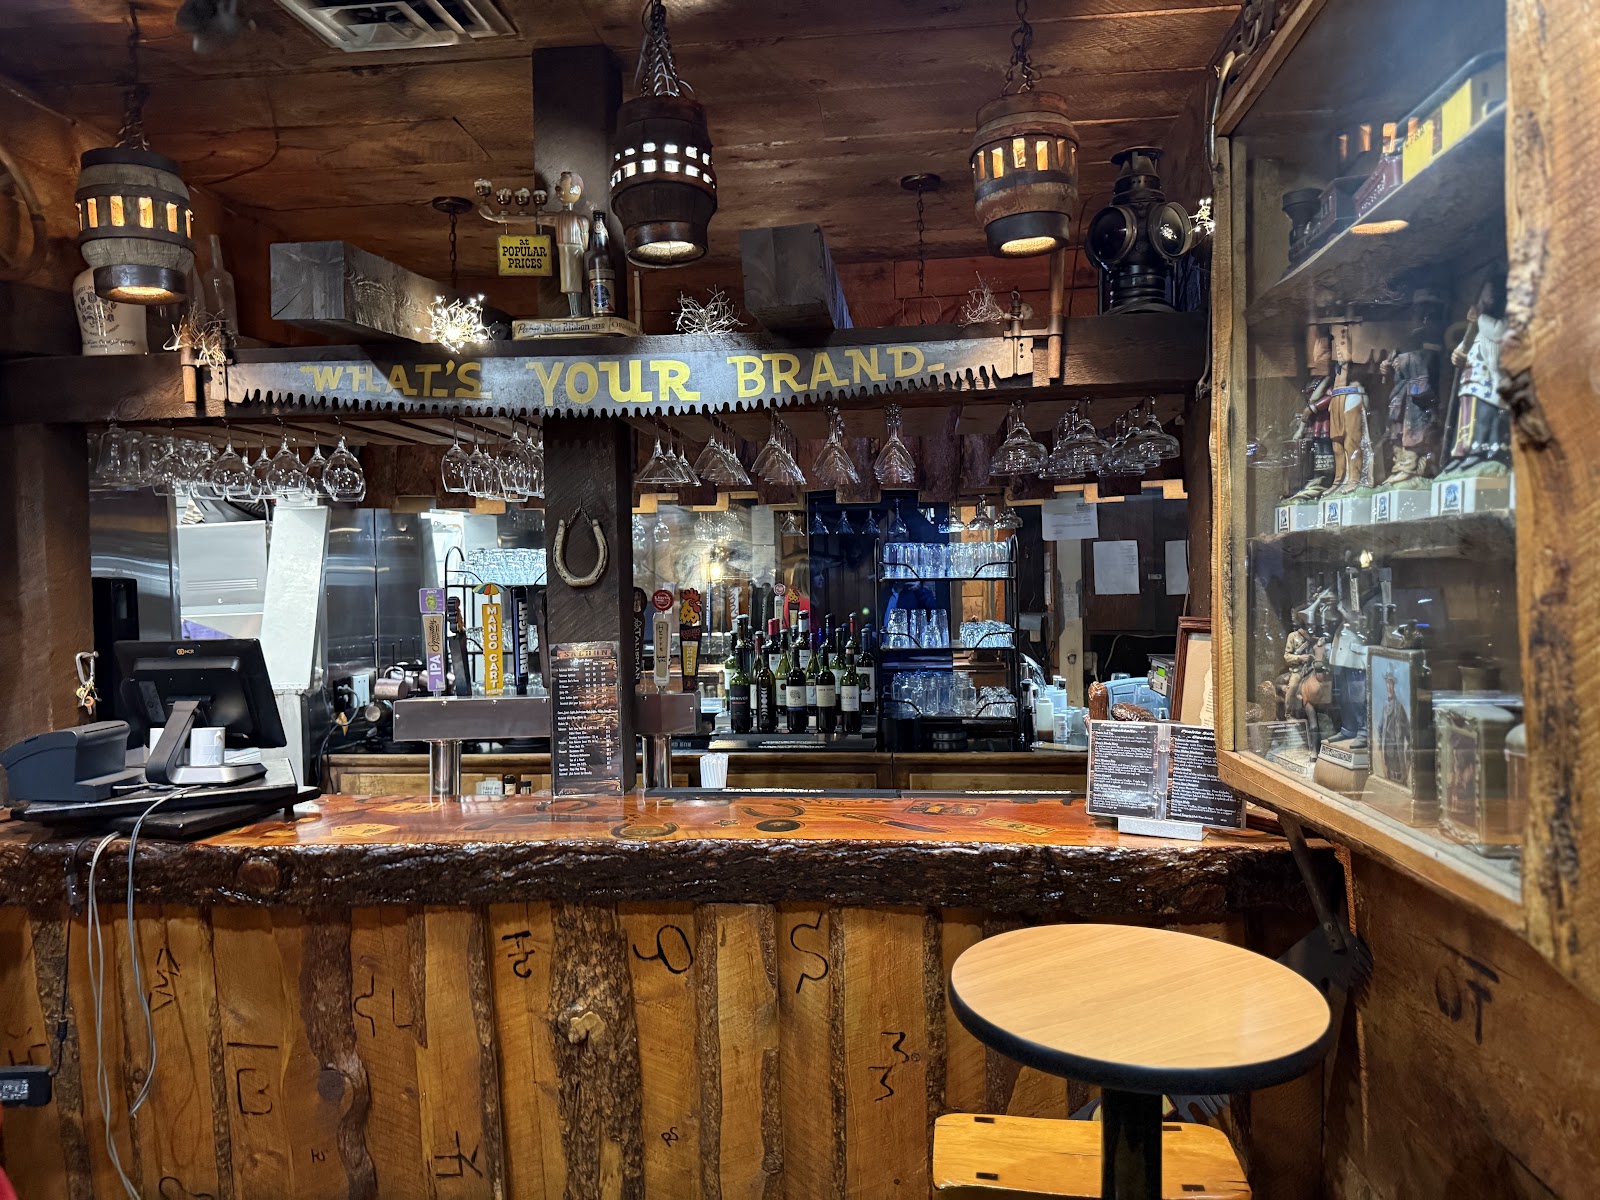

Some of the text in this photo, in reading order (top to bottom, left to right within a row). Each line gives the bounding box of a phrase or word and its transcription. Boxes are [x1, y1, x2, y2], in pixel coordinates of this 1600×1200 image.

[502, 245, 547, 258] POPULAR
[519, 238, 530, 246] at
[508, 258, 543, 269] PRICES
[299, 359, 493, 400] WHAT'S
[525, 359, 701, 407] YOUR
[487, 606, 498, 650] MANGO
[518, 601, 528, 674] BUD LIGHT
[429, 654, 441, 676] IPA
[489, 653, 499, 689] CART
[634, 627, 642, 680] TALISMAN
